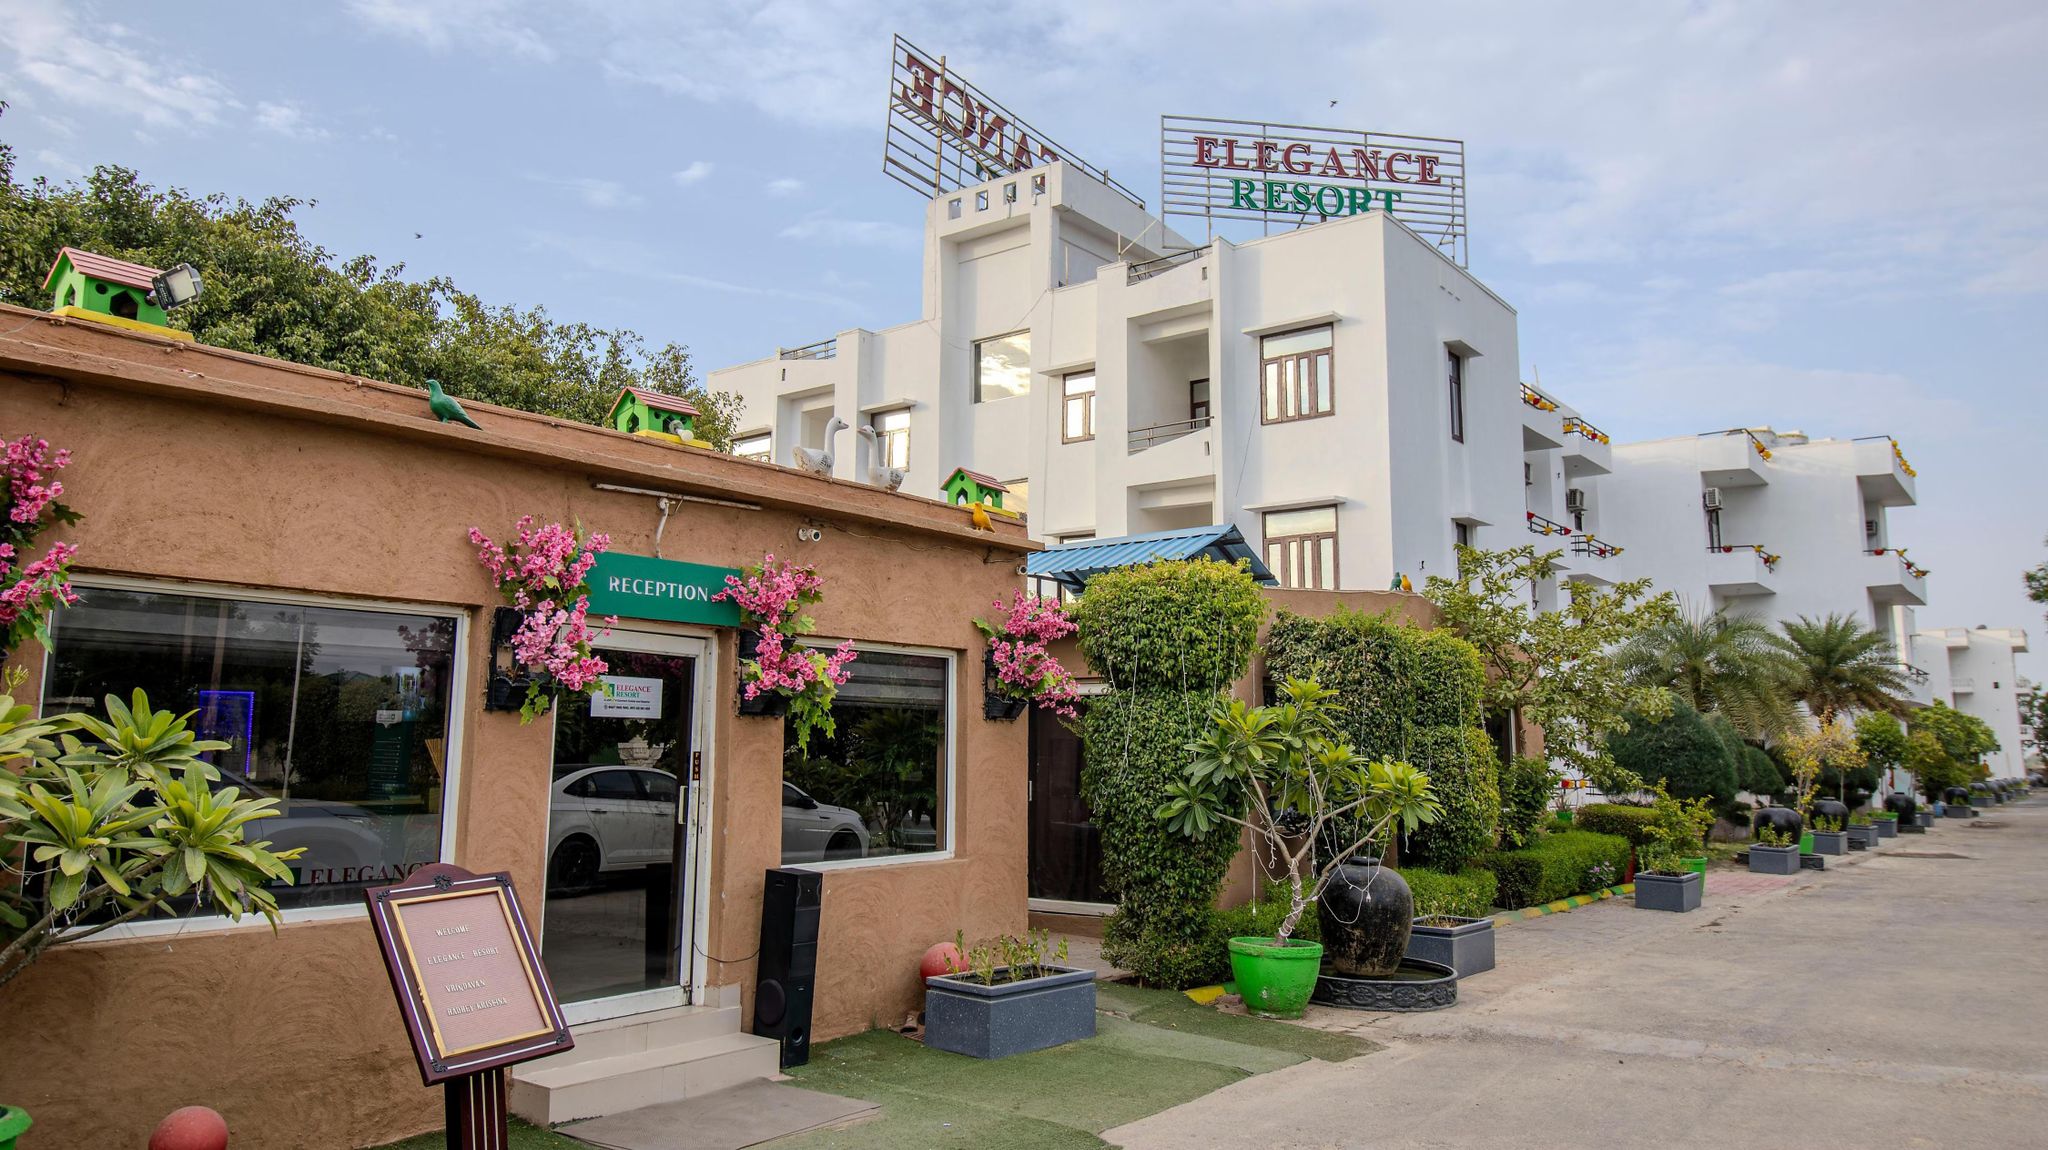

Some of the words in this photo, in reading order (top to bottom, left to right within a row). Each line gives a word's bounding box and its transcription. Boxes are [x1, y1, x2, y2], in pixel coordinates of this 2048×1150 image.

[1193, 135, 1442, 184] ELEGANCE
[1228, 178, 1402, 216] RESORT
[608, 576, 709, 602] RECEPTION
[616, 683, 652, 693] ELEGANCE
[616, 691, 640, 699] RESORT
[435, 925, 470, 936] WELCOME
[427, 951, 465, 965] ELEGANCE
[472, 946, 499, 957] RESORT
[445, 979, 486, 993] VRINDAVAN
